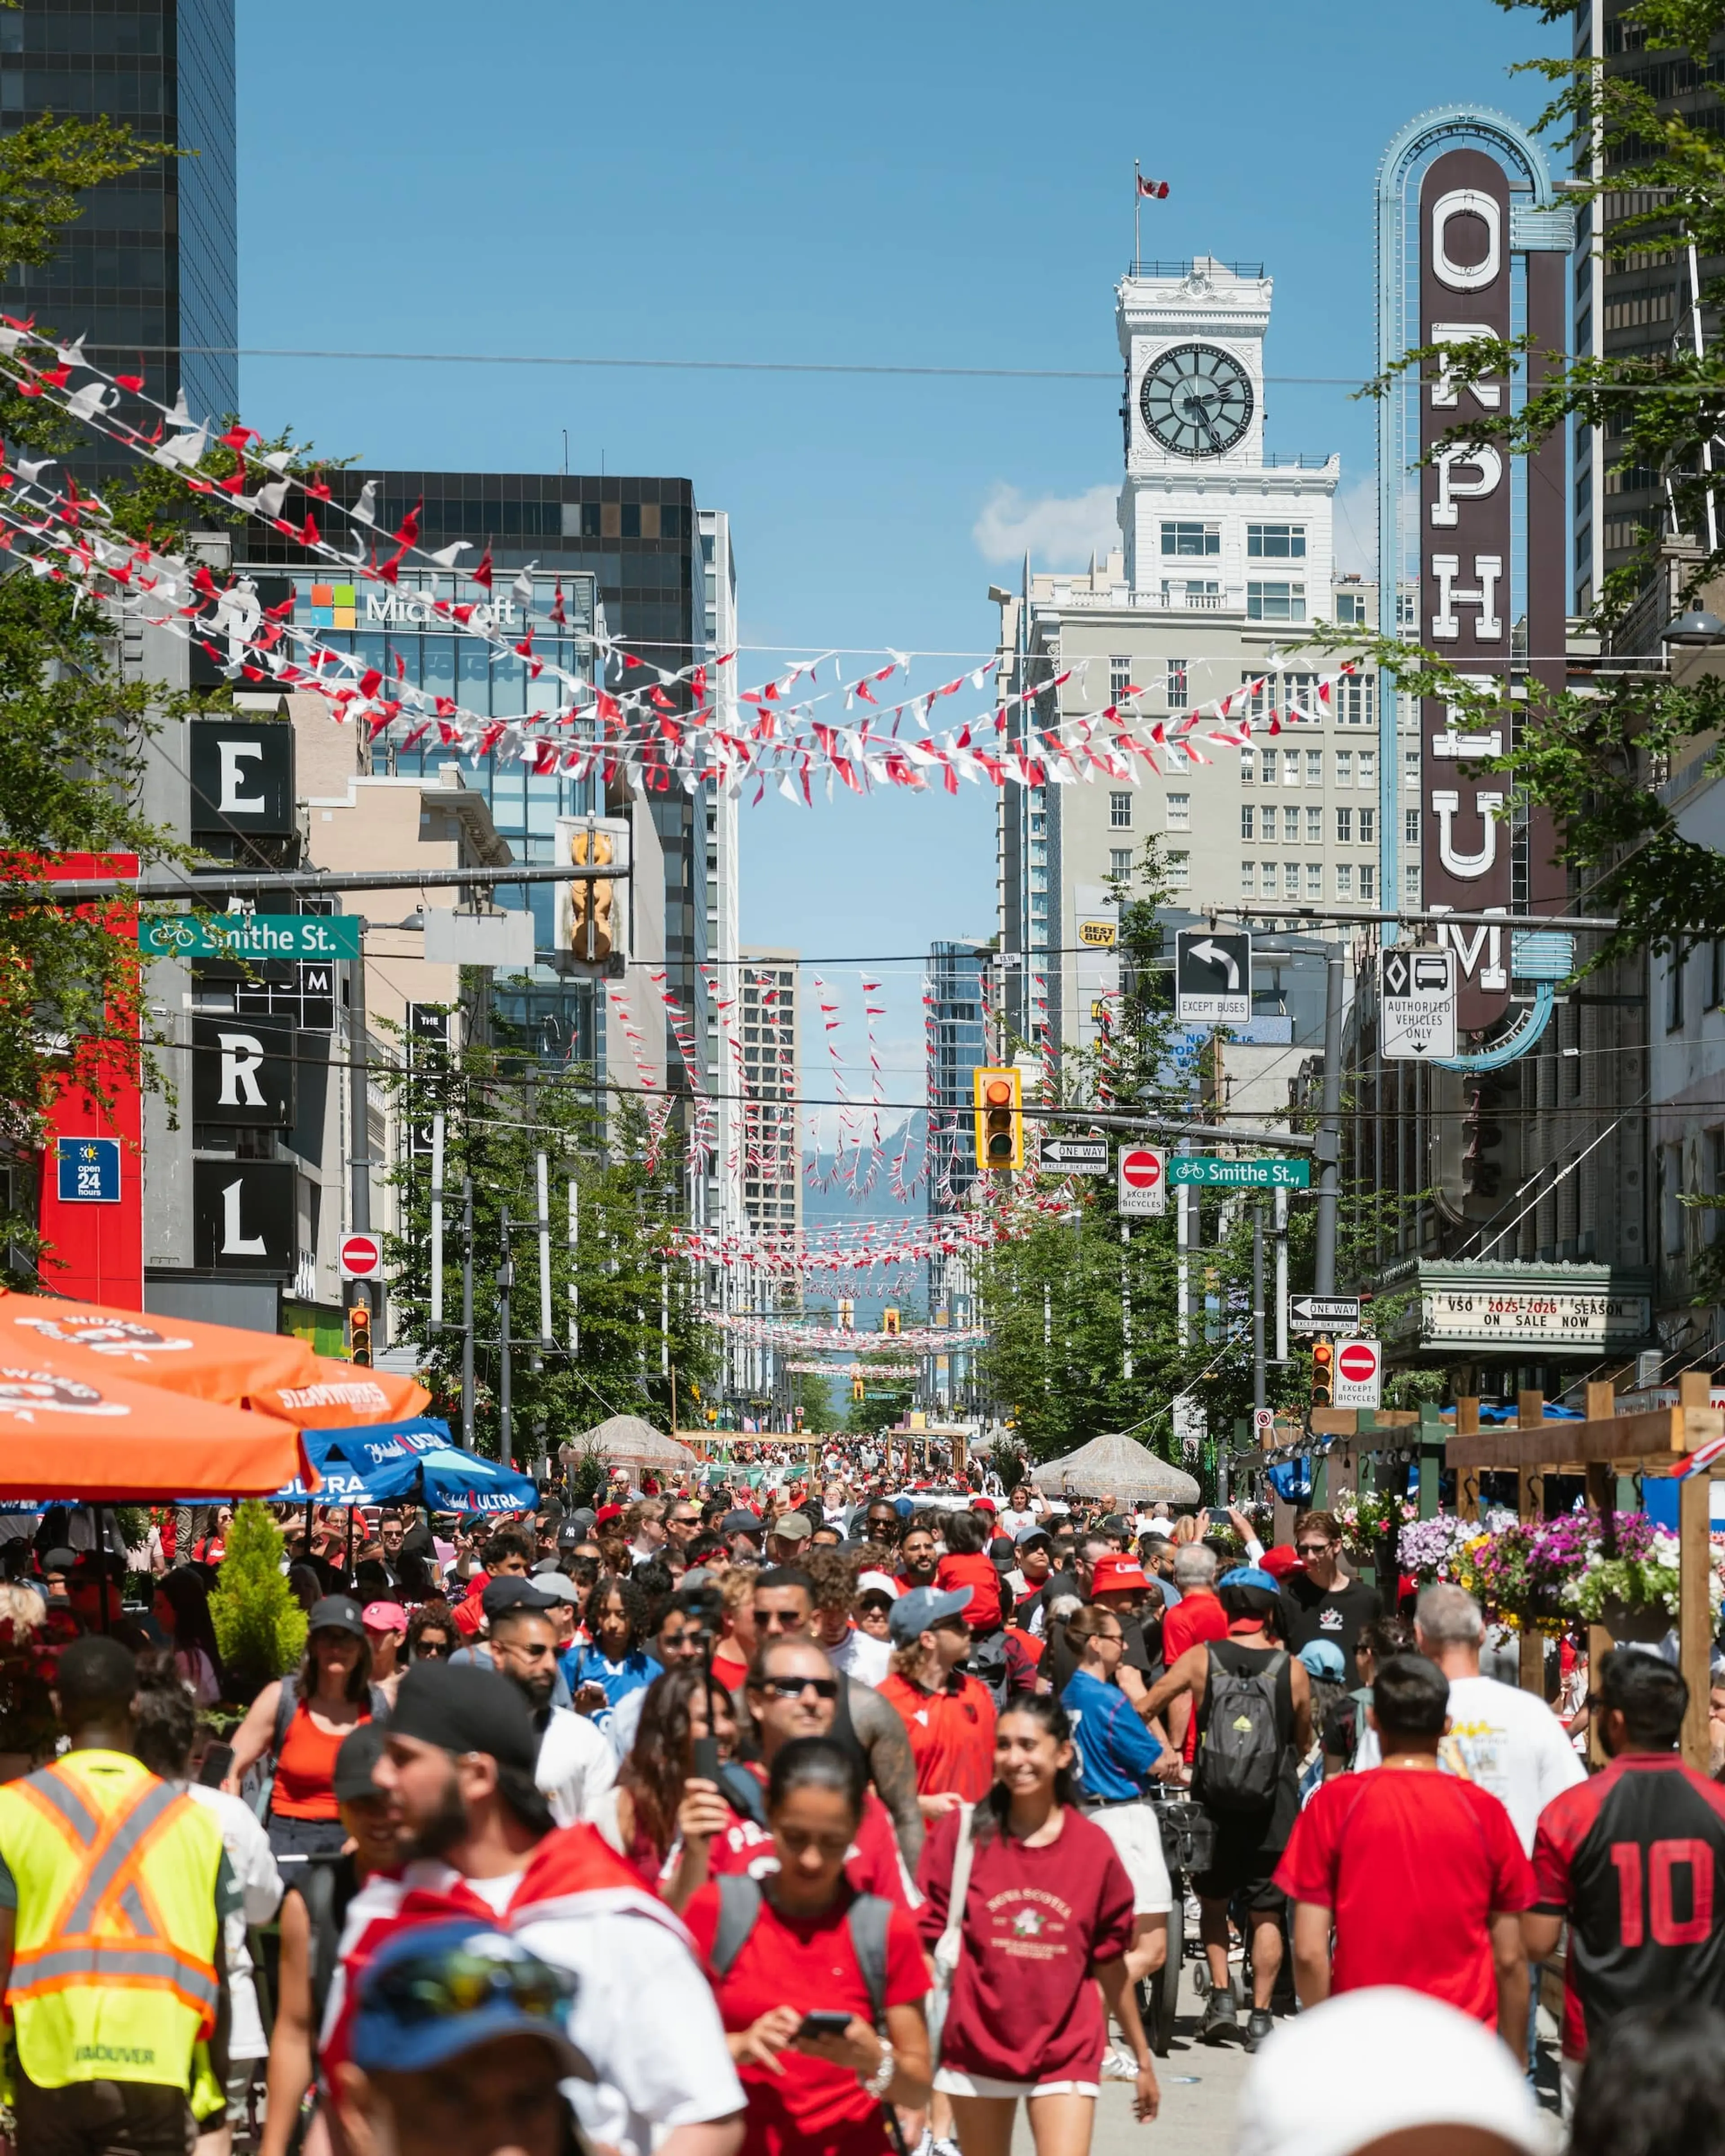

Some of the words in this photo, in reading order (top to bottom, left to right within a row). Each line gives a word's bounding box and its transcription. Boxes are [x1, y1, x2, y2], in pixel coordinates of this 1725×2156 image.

[1430, 189, 1507, 989] ORPHEUM
[1084, 925, 1115, 935] BEST
[301, 924, 336, 951] St.
[1085, 933, 1110, 942] BUY
[1182, 1001, 1213, 1012] EXCEPT
[1217, 1002, 1245, 1012] BUSES
[1388, 1001, 1451, 1012] AUTHORIZED
[421, 1016, 439, 1025] THE
[1396, 1014, 1443, 1025] VEHICLES
[1406, 1029, 1432, 1038] ONLY
[1059, 1147, 1078, 1156] ONE
[1083, 1148, 1103, 1156] WAY
[1209, 1164, 1268, 1181] Smithe
[1272, 1165, 1295, 1182] St.
[77, 1173, 101, 1189] 24
[1310, 1304, 1330, 1313] ONE
[1334, 1305, 1354, 1314] WAY
[1448, 1301, 1473, 1312] VSO
[1488, 1301, 1557, 1314] 2025-2026
[1575, 1303, 1623, 1315] SEASON
[1484, 1314, 1500, 1325] ON
[1516, 1315, 1547, 1327] SALE
[1562, 1316, 1590, 1328] NOW
[477, 1493, 526, 1510] ULTRA
[1610, 1839, 1715, 1947] 10
